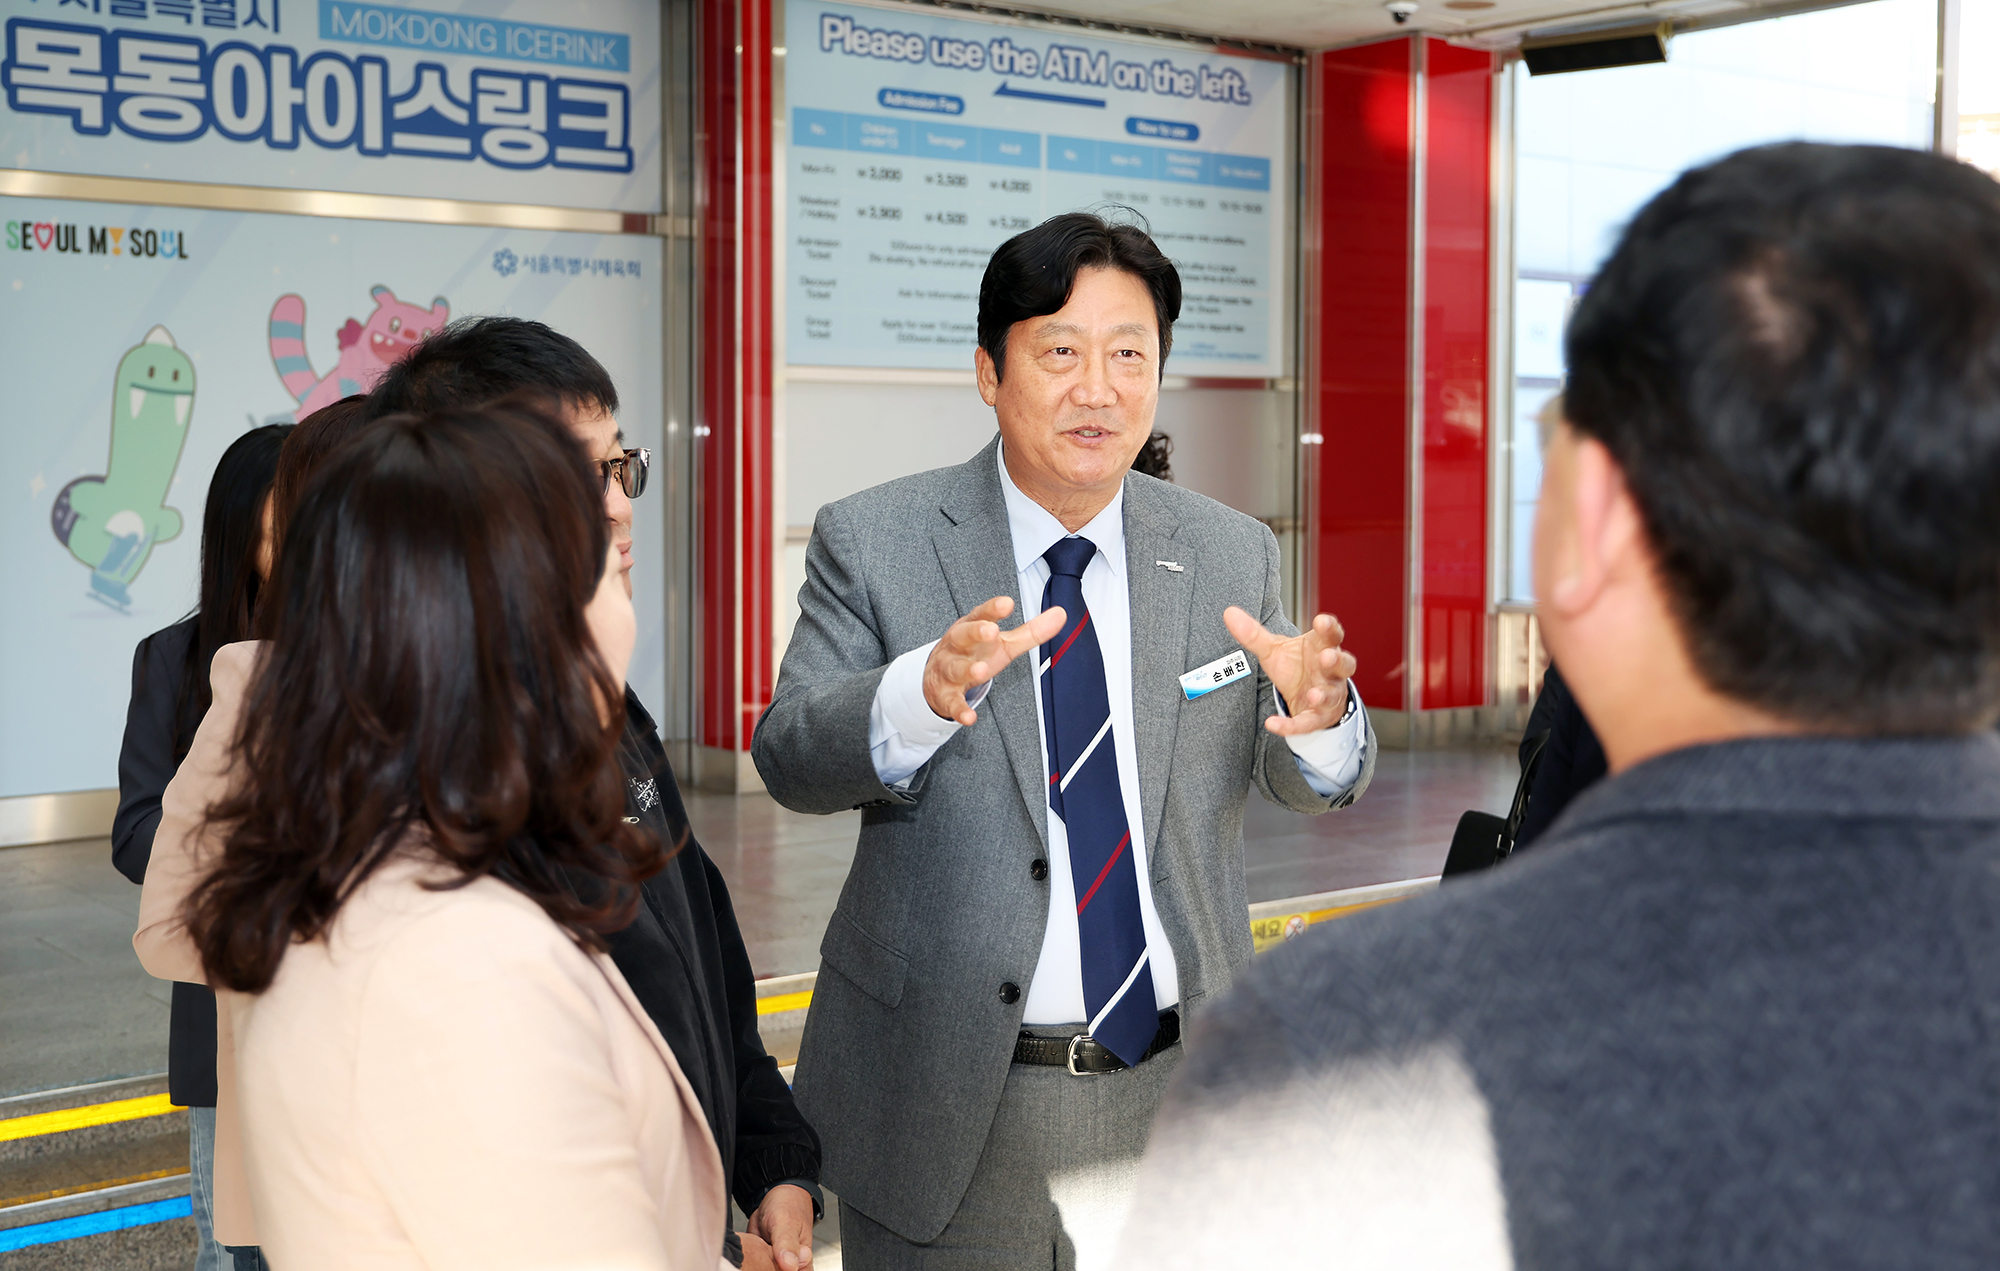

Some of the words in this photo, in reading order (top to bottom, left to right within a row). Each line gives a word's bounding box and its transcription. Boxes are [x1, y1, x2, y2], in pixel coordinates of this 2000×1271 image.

[58, 0, 280, 34] 특별시
[331, 11, 498, 53] MOKDONG
[504, 25, 619, 66] ICERINK
[820, 13, 925, 62] Please
[929, 38, 984, 71] use
[989, 37, 1039, 77] the
[1042, 44, 1108, 86] ATM
[1112, 63, 1148, 92] on
[1150, 60, 1195, 98] the
[1199, 65, 1251, 105] left.
[3, 18, 633, 173] 목동아이스링크
[130, 228, 189, 259] SOUL
